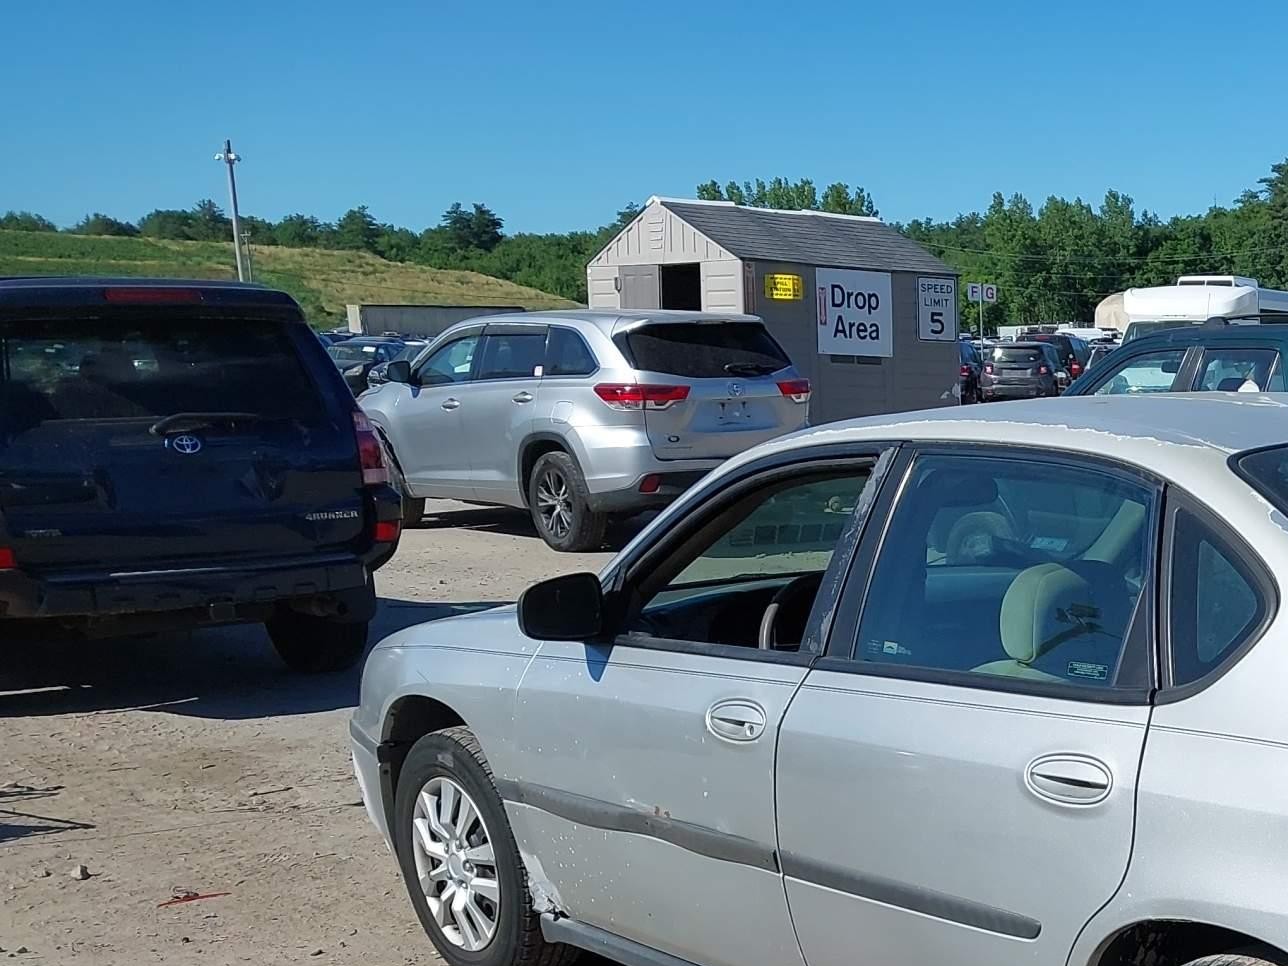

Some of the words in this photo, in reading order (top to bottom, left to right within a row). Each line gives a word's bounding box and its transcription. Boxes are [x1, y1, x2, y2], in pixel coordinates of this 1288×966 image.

[920, 283, 953, 294] SPEED
[971, 286, 978, 298] F
[985, 287, 995, 299] G
[831, 284, 880, 315] Drop
[924, 298, 950, 308] LIMIT
[833, 315, 880, 341] Area
[930, 311, 945, 335] 5
[304, 510, 359, 521] 4RUNNER
